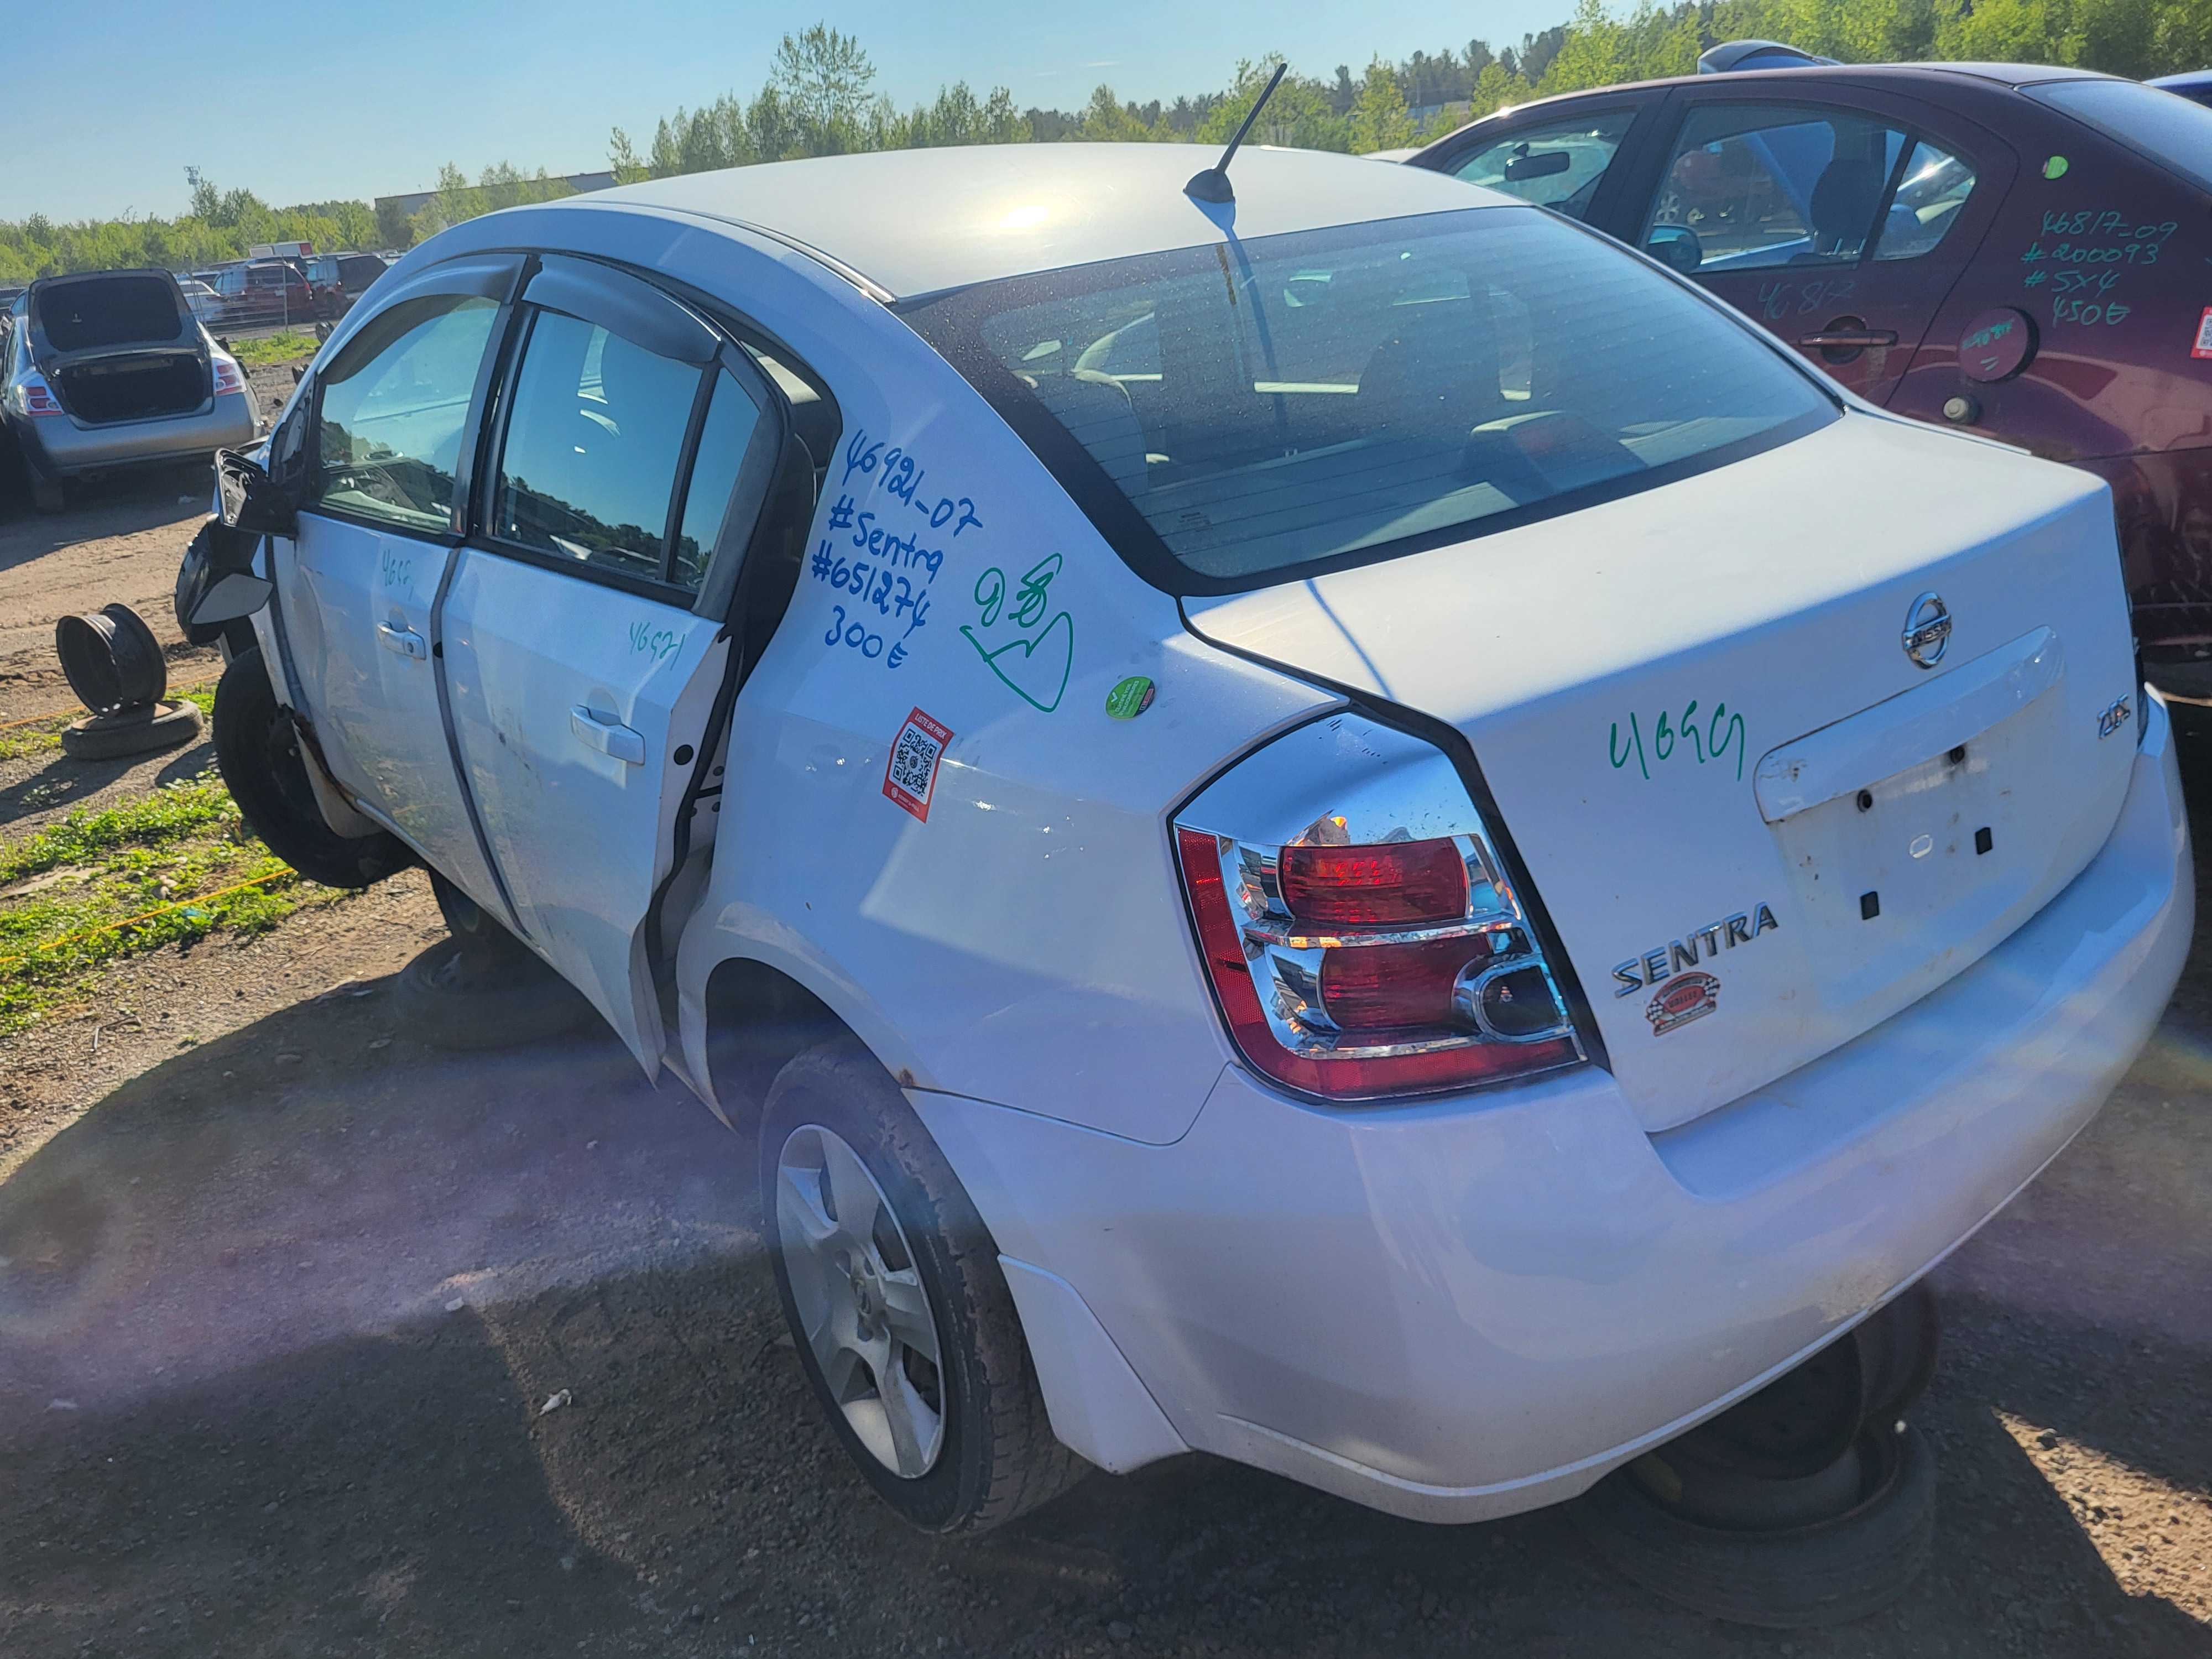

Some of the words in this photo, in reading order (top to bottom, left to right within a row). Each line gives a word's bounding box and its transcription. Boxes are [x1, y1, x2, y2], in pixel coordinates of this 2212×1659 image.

[915, 713, 927, 727] LISTE
[927, 721, 936, 732] DE
[933, 726, 947, 739] PRIX
[1611, 901, 1779, 999] SENTRA
